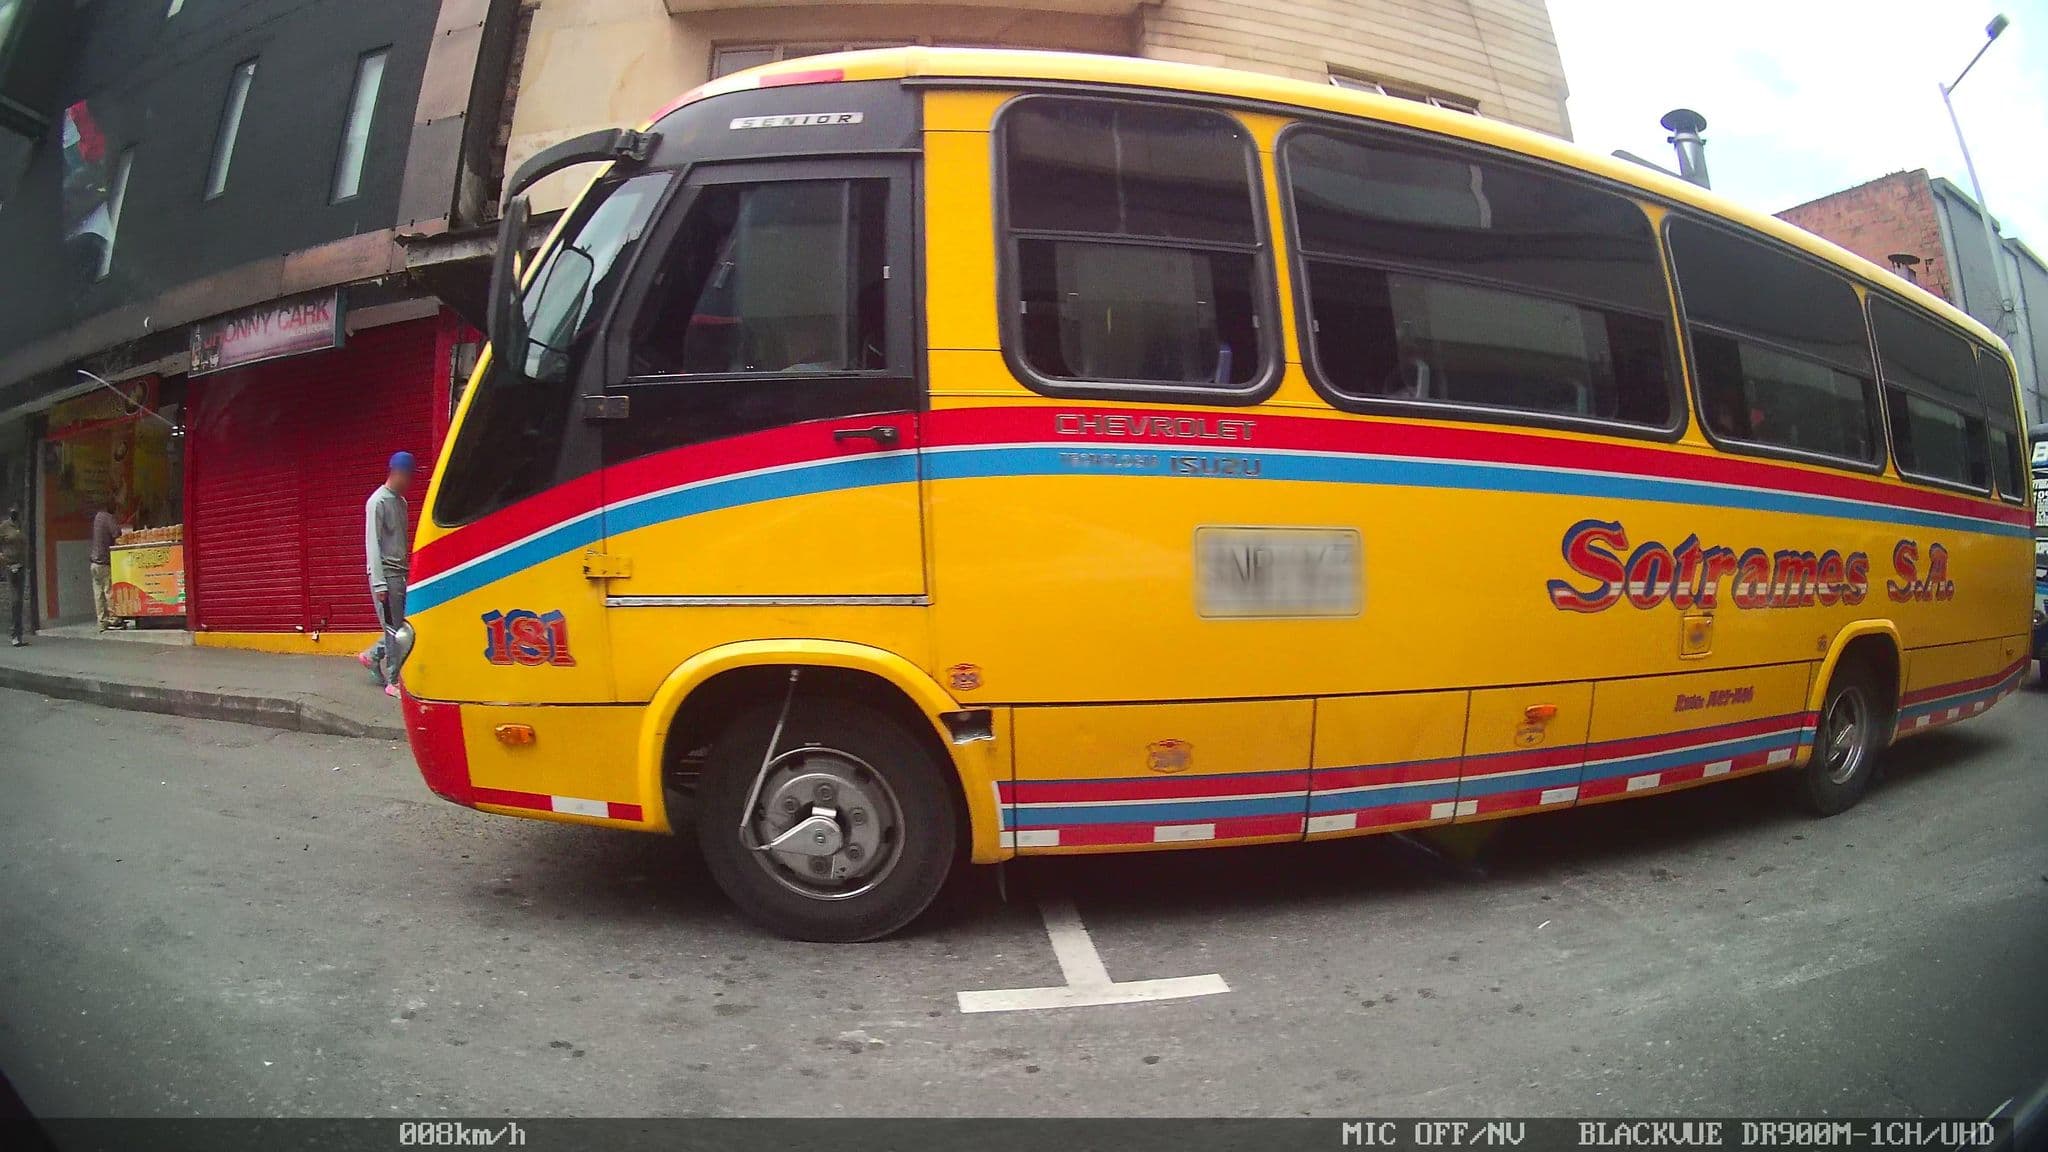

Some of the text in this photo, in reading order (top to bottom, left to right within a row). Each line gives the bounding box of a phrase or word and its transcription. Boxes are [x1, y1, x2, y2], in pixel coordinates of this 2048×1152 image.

[741, 113, 852, 129] SENIOR
[1055, 413, 1257, 440] CHEVROLET
[1170, 455, 1261, 477] ISUZU
[1547, 519, 1870, 614] Sotrames
[481, 609, 577, 667] 181
